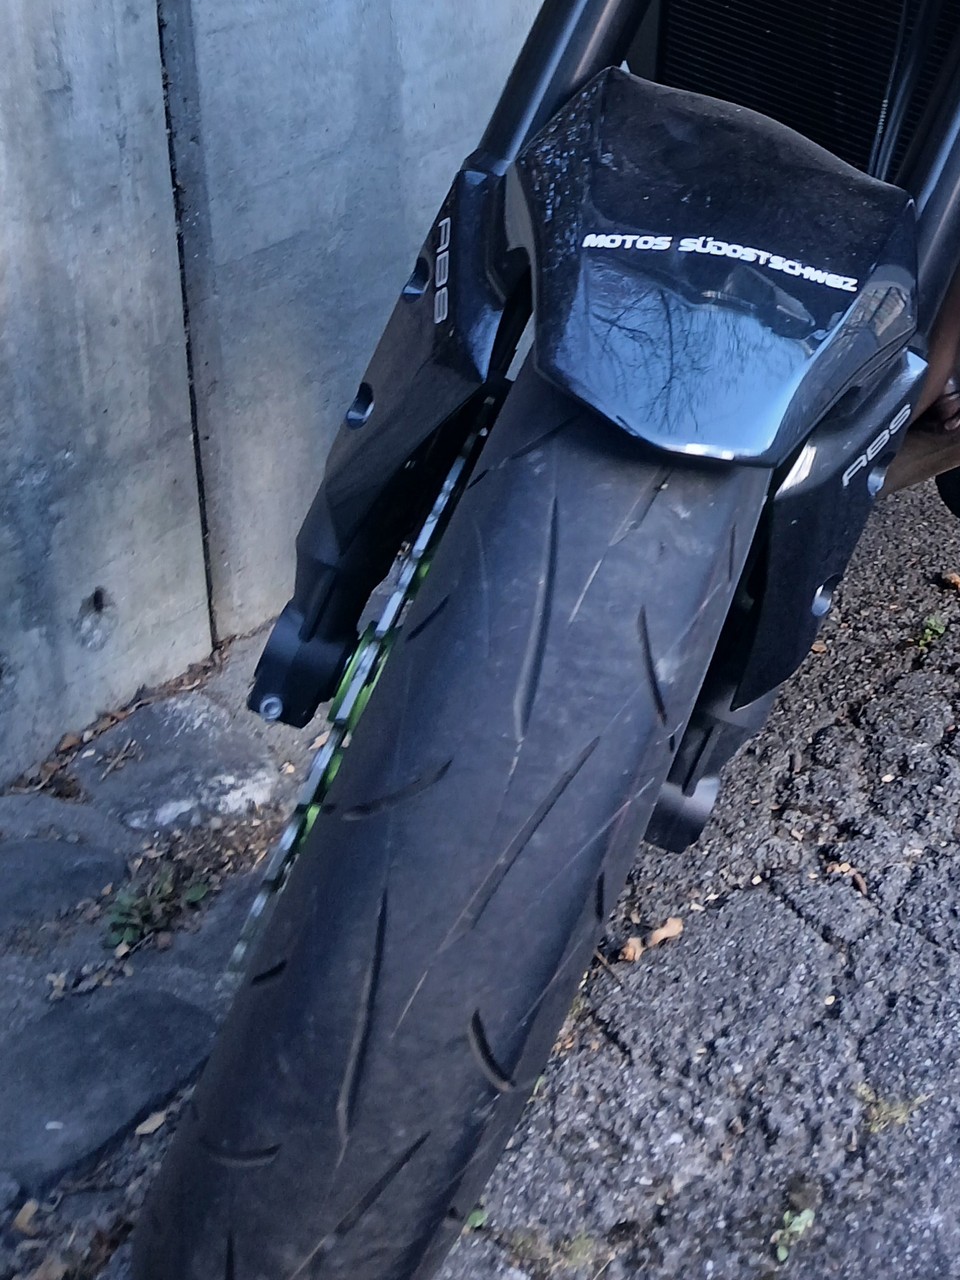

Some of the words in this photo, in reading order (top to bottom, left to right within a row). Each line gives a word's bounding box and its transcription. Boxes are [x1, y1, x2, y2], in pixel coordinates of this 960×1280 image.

[434, 217, 450, 324] ABS
[582, 234, 672, 250] MOTOS
[842, 403, 912, 488] ABS
